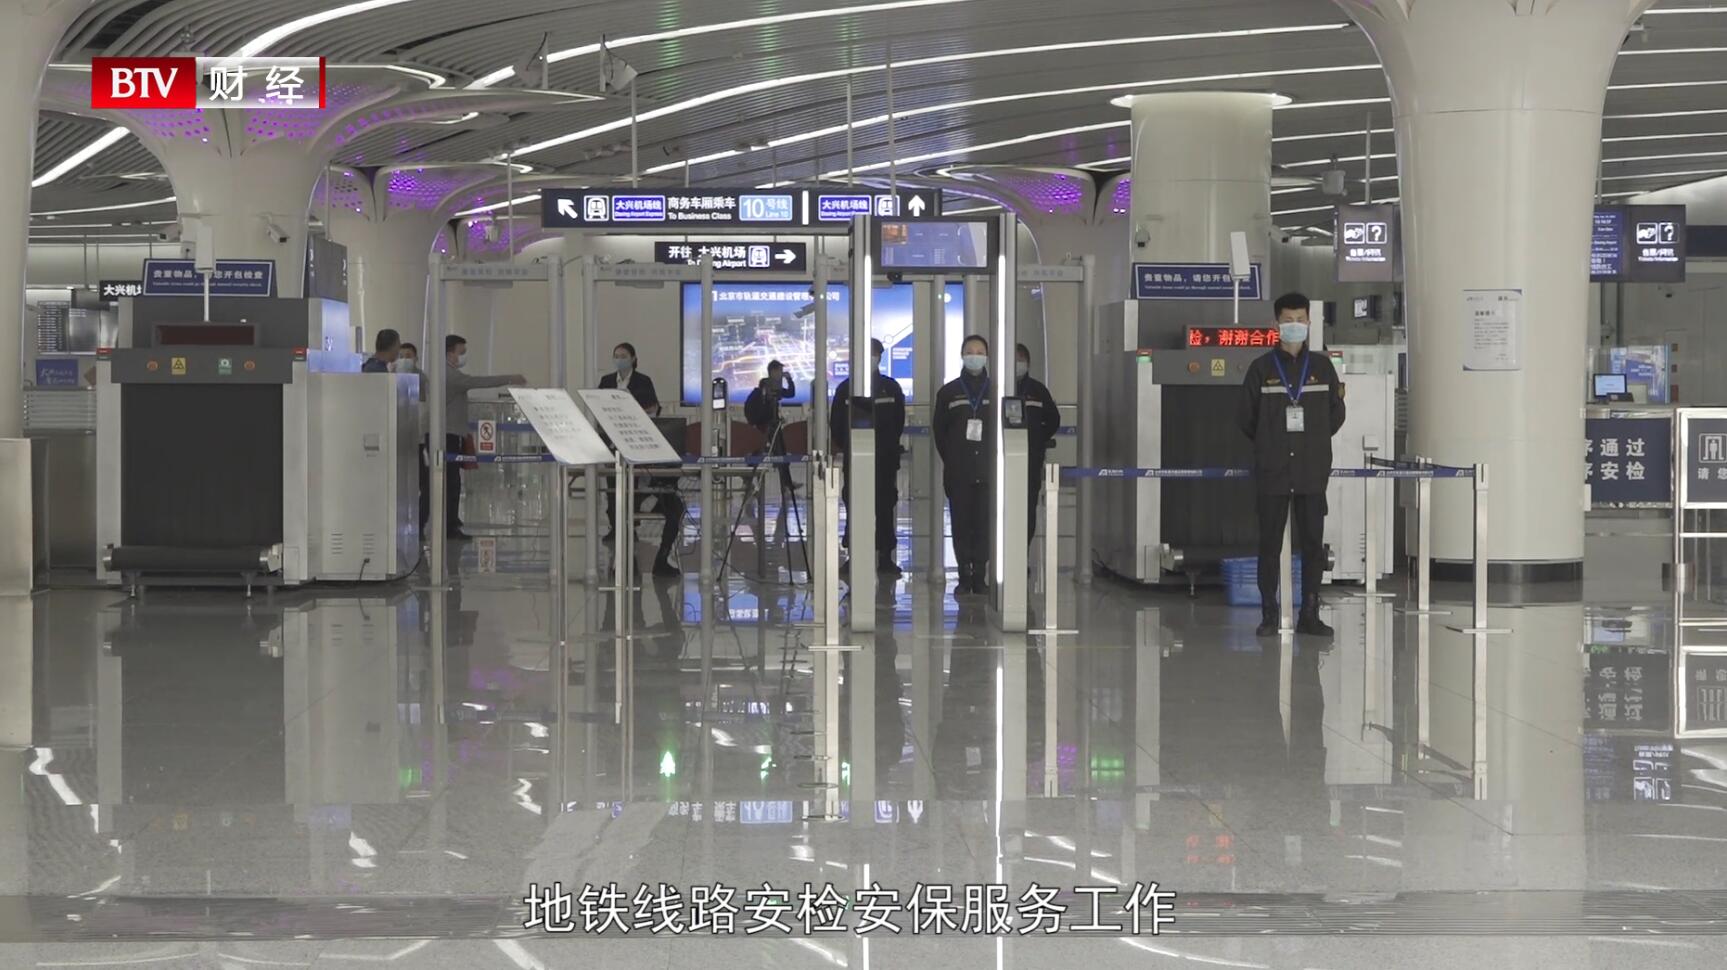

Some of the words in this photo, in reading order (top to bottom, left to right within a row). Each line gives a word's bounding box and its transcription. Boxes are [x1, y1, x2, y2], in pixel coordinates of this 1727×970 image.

[615, 200, 662, 210] 大兴机场线
[667, 196, 736, 209] 商务车厢乘车
[743, 198, 764, 218] 10
[766, 198, 788, 210] 号线
[667, 212, 677, 220] To
[678, 212, 710, 220] Business
[711, 212, 732, 220] Class
[668, 246, 692, 259] 开往
[698, 246, 746, 258] 大兴机场
[153, 270, 263, 279] 贵重物品，您开包检查
